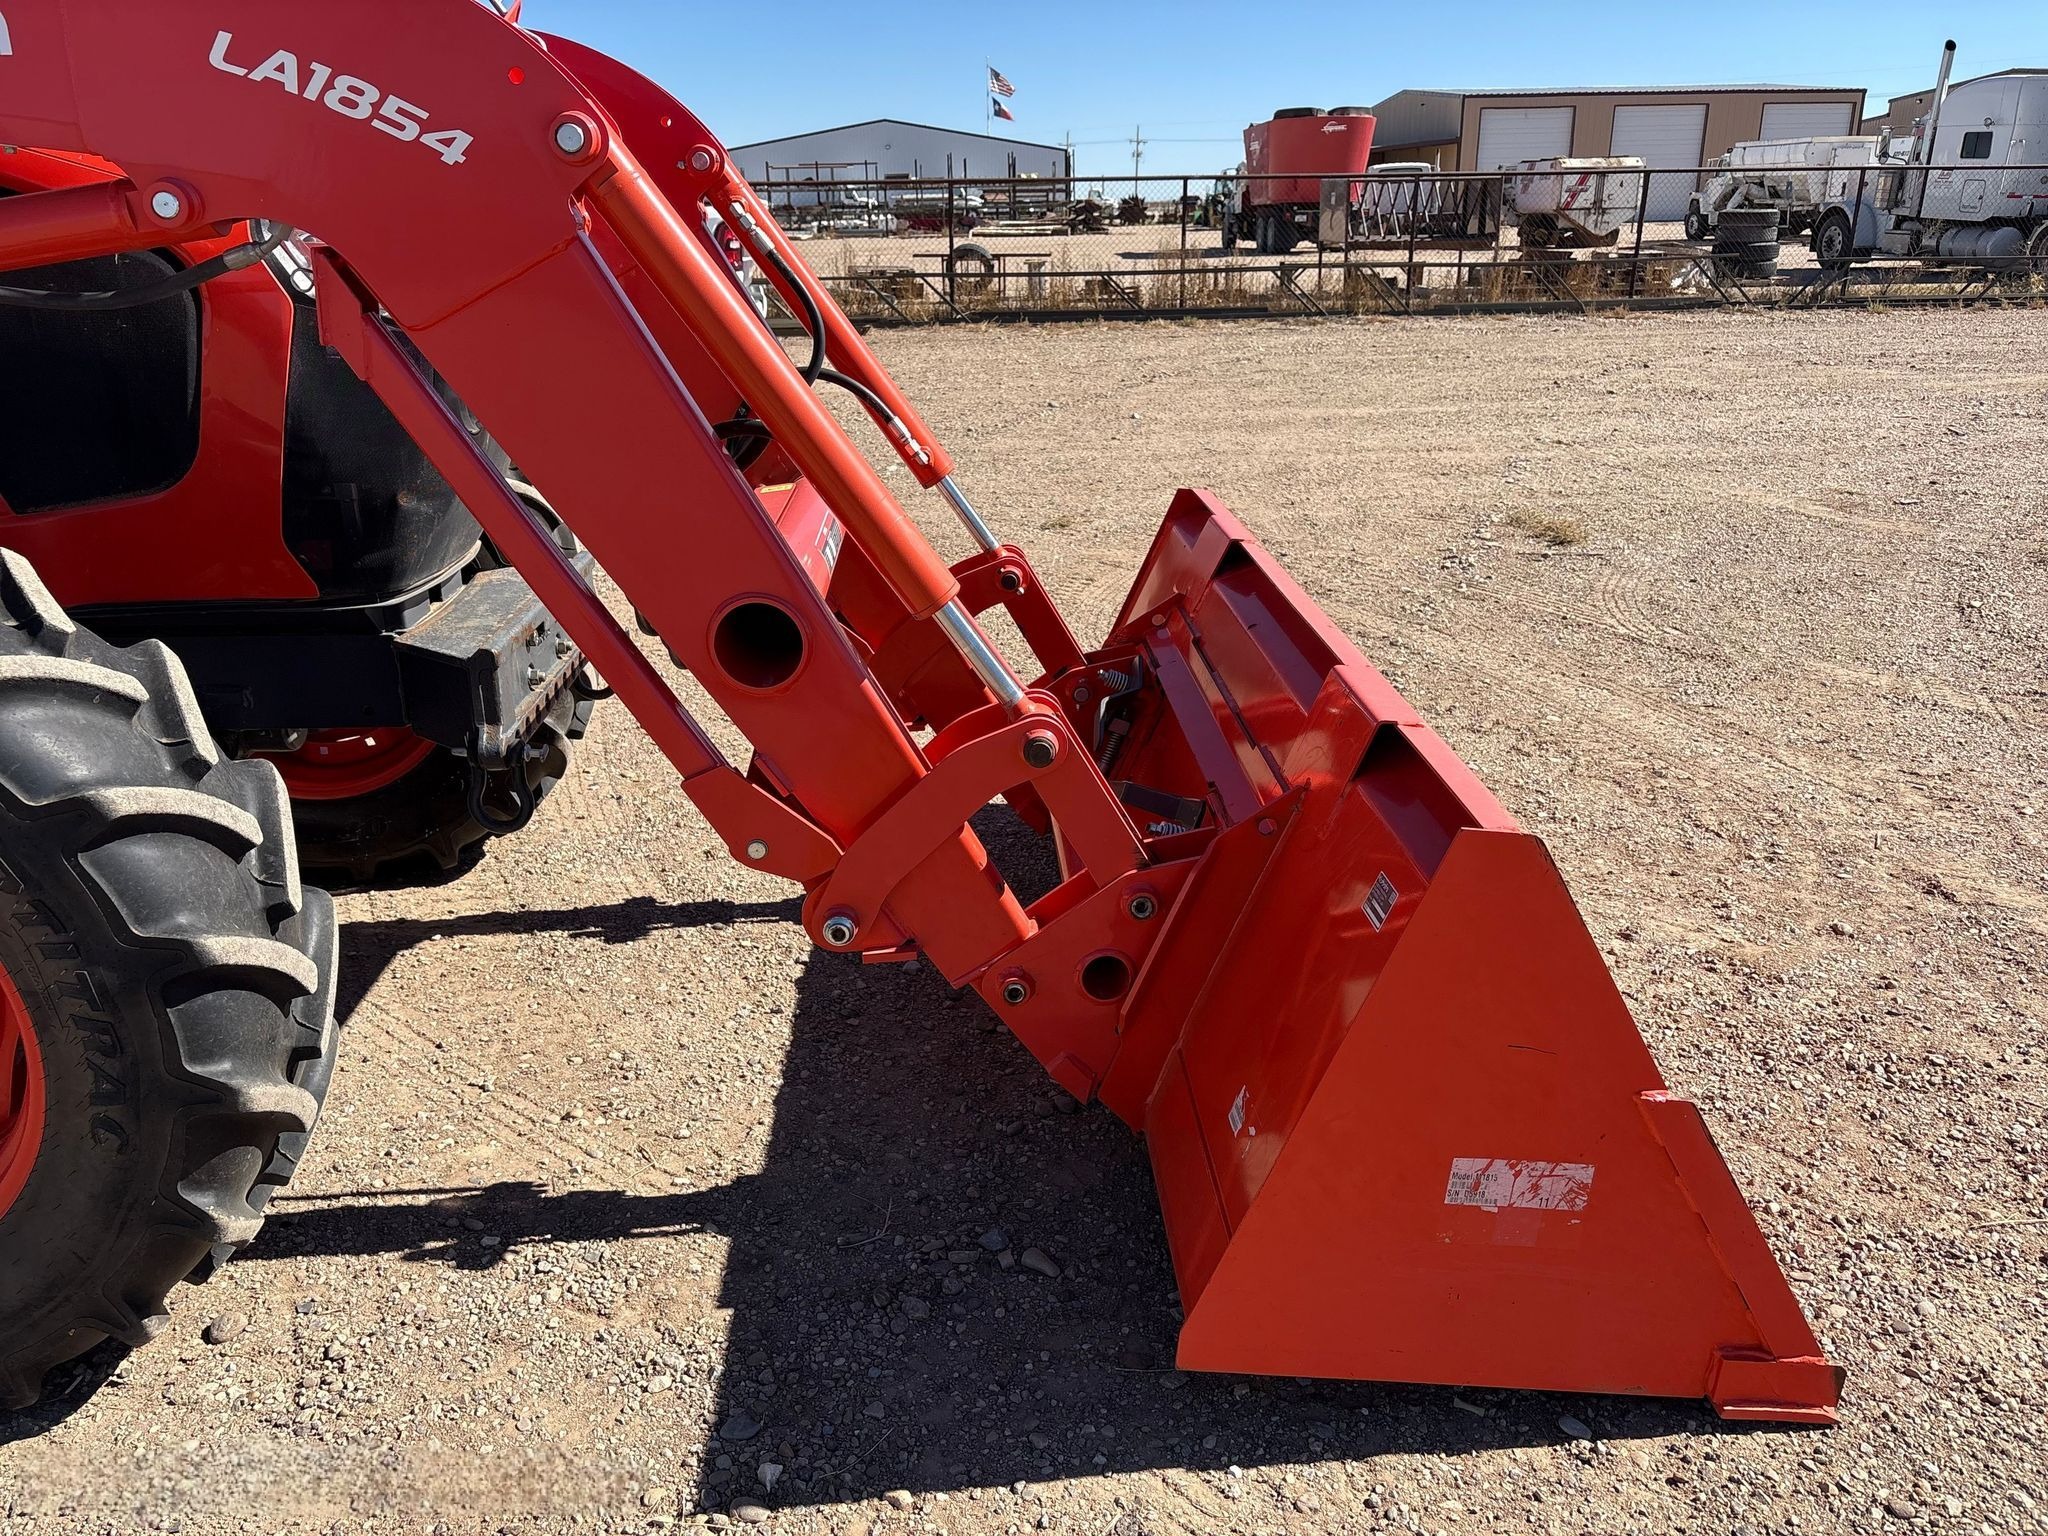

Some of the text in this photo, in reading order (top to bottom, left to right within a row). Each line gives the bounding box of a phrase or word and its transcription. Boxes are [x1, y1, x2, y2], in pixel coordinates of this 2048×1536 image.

[208, 30, 474, 166] LA1854
[1451, 1171, 1473, 1181] Model
[1447, 1189, 1460, 1198] S/N
[1538, 1197, 1550, 1208] 11
